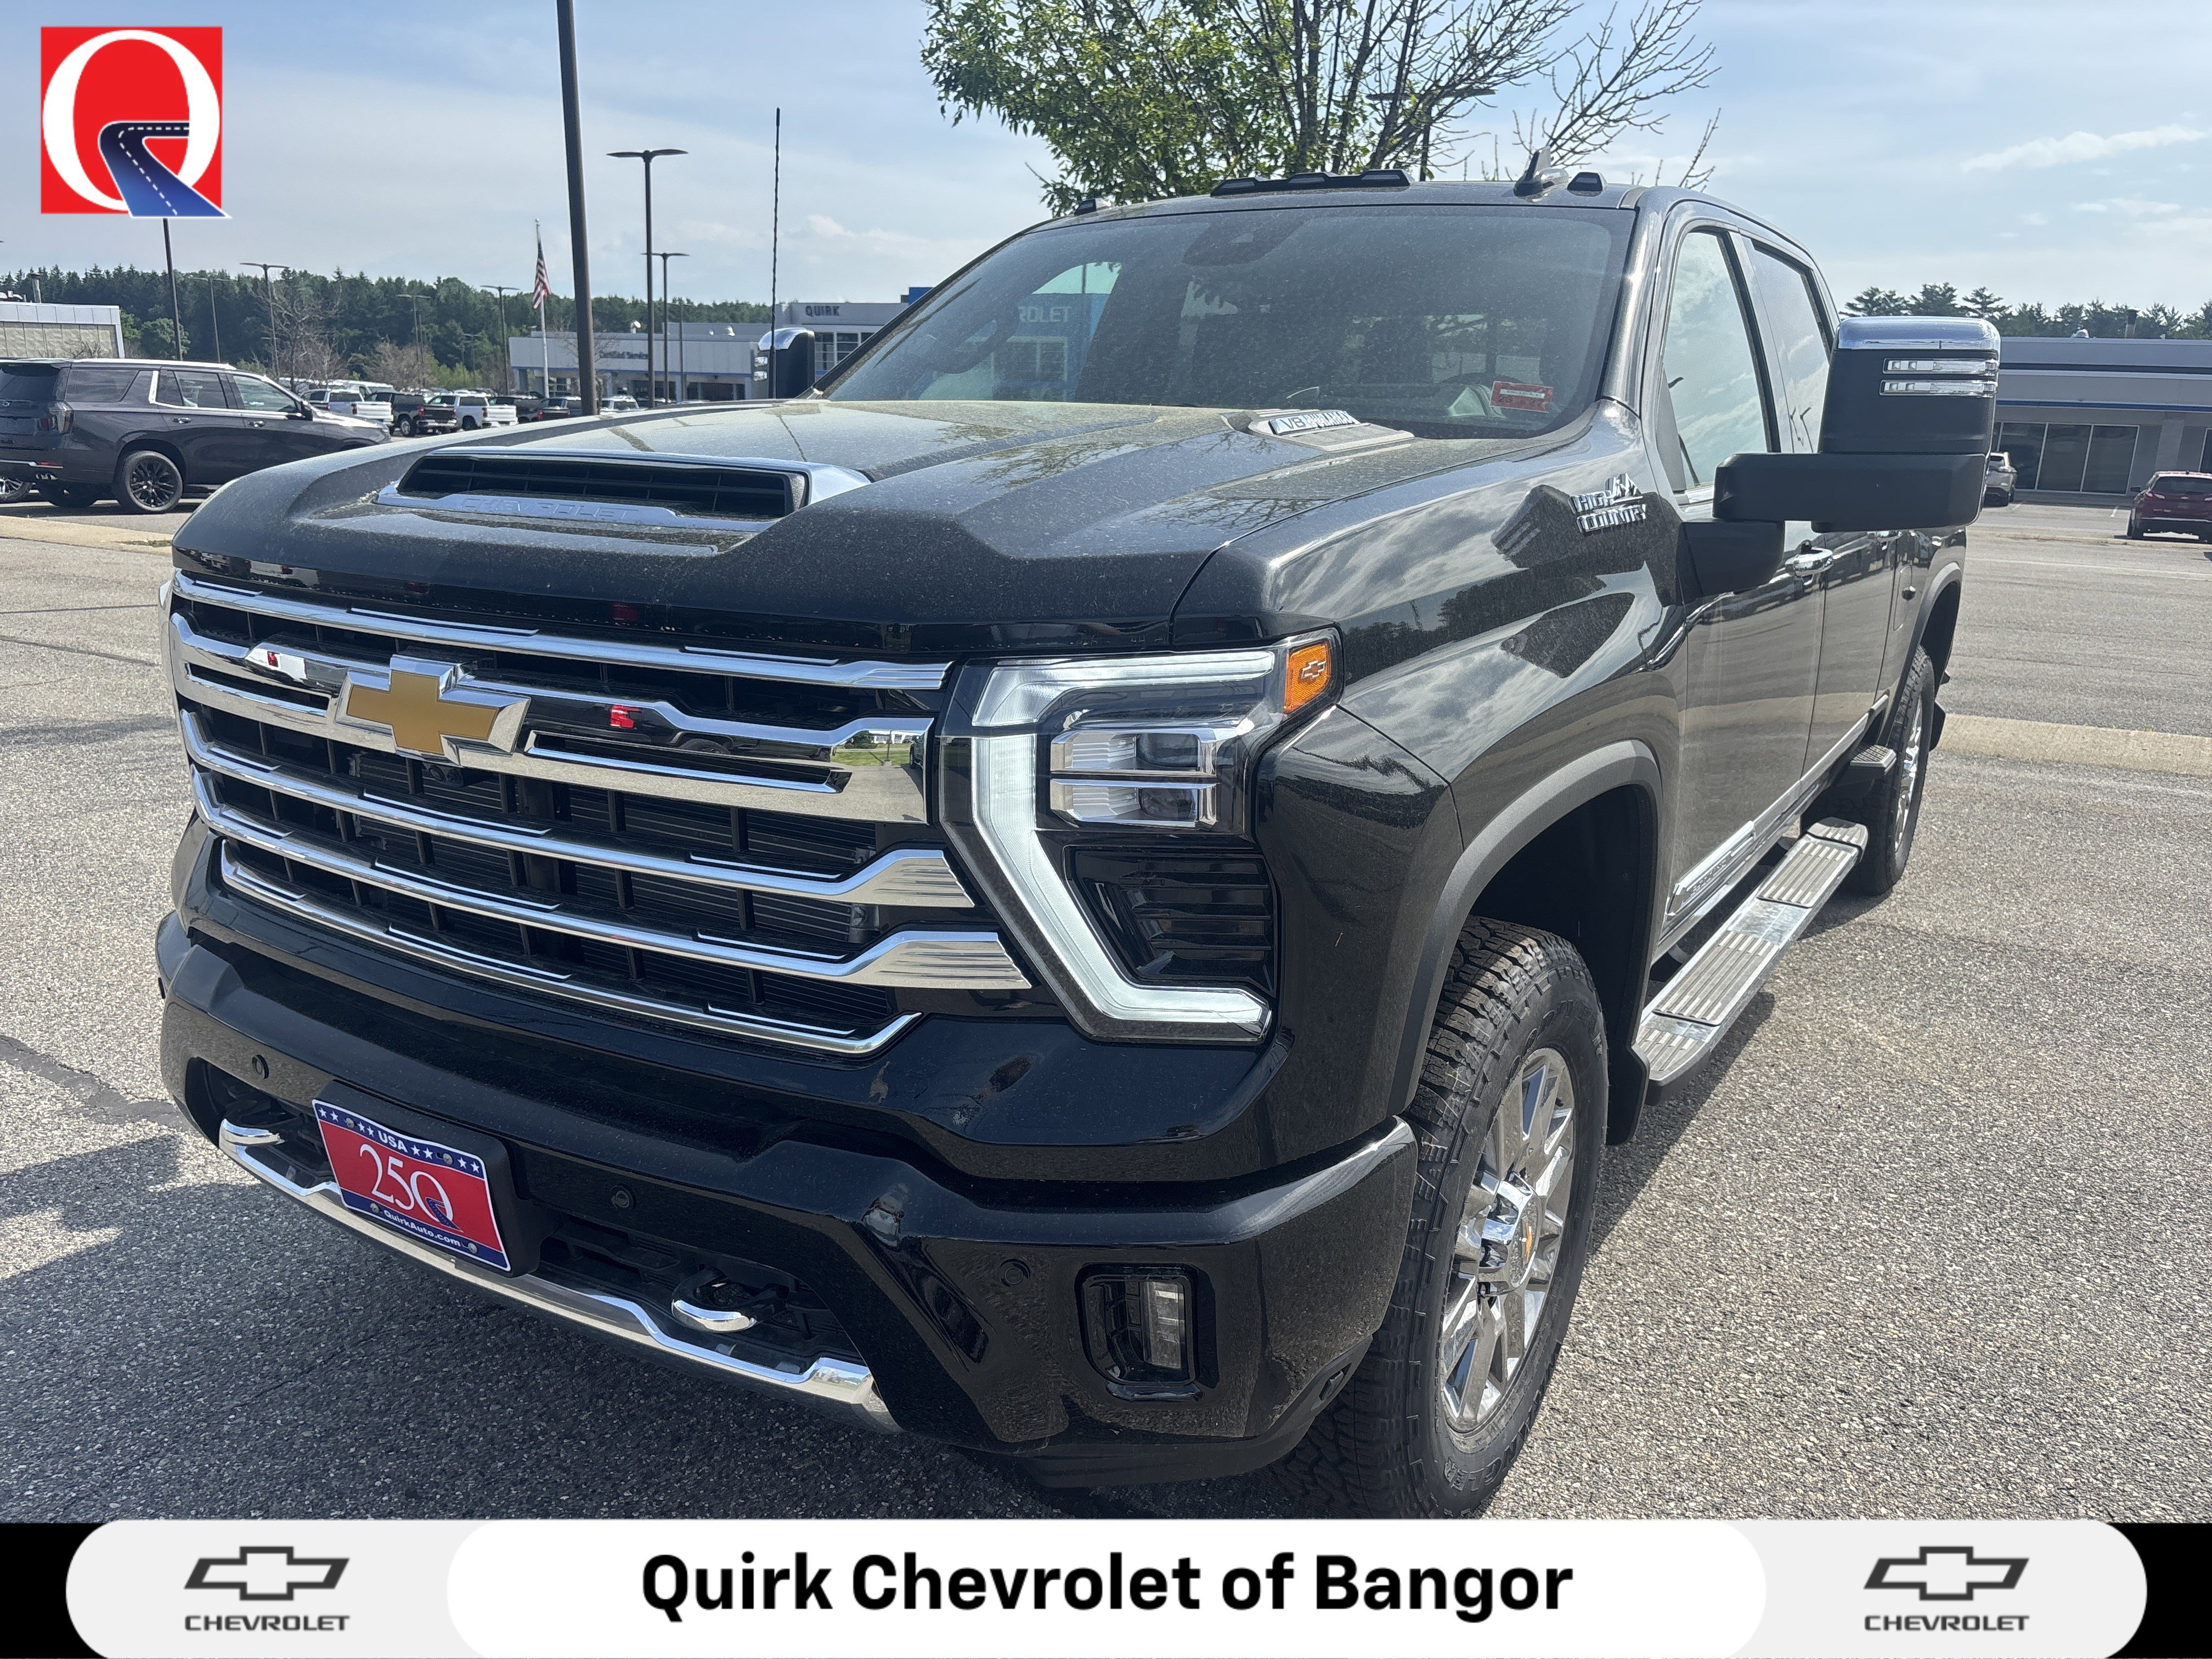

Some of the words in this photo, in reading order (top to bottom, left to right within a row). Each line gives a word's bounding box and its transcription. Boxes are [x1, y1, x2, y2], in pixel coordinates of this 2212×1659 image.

[805, 305, 840, 317] QUIRK
[463, 498, 639, 520] CHEVROLET
[1577, 504, 1646, 533] COUNTRY
[377, 1130, 408, 1153] USA
[383, 1209, 461, 1247] QuirkAuto.com
